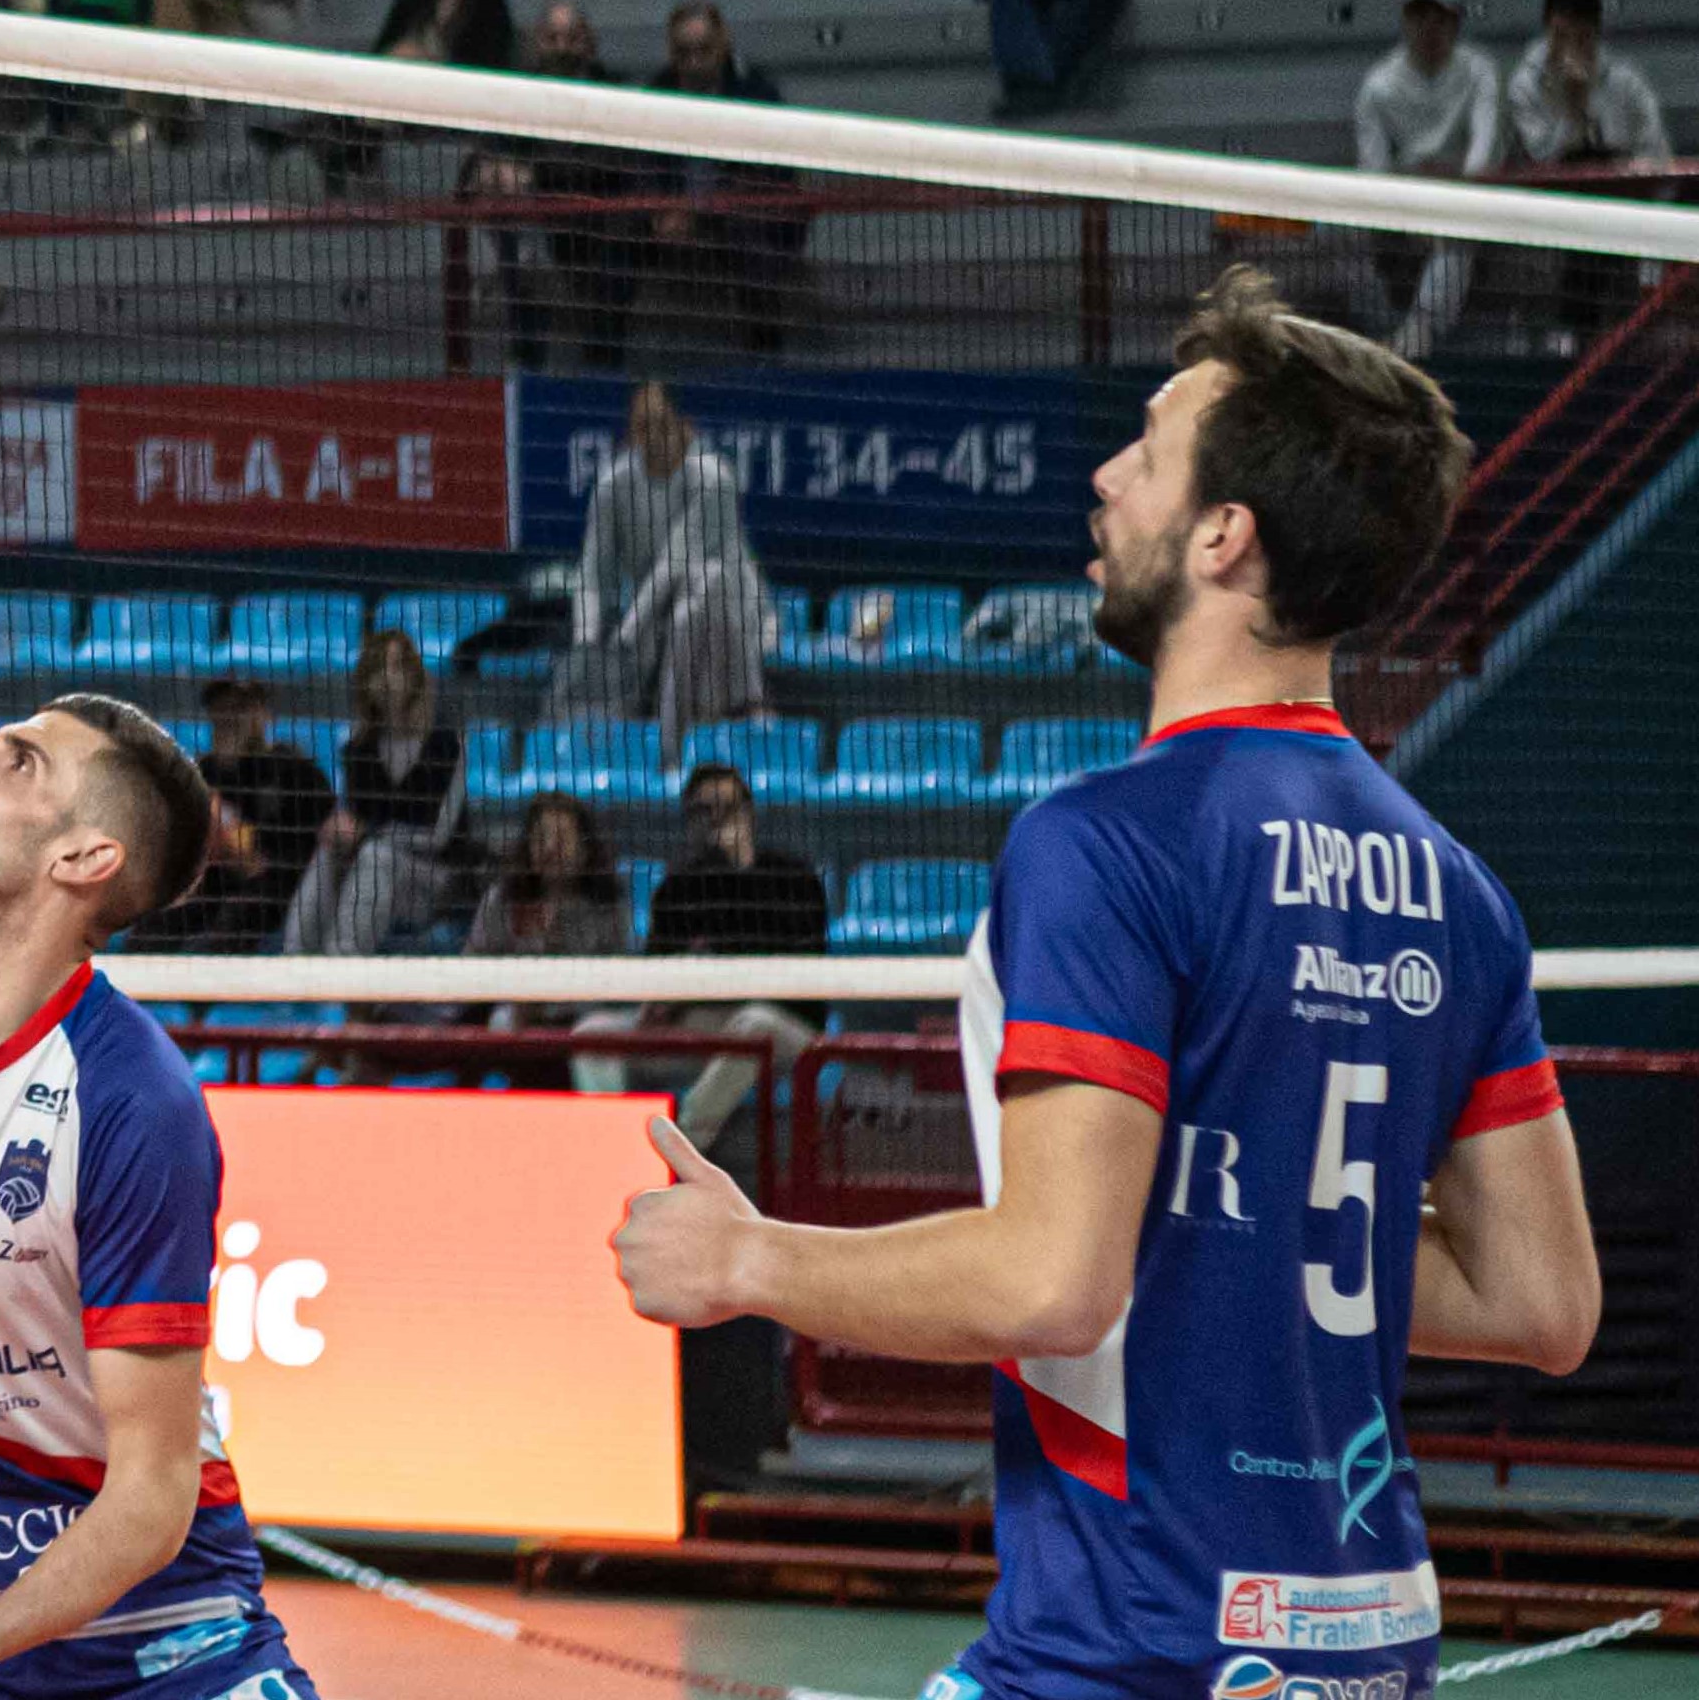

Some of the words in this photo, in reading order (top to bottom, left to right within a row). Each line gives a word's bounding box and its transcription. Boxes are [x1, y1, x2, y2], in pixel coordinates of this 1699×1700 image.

[134, 434, 282, 506] FILA
[305, 429, 437, 503] A-E
[806, 421, 1036, 498] 34-45
[1260, 819, 1444, 922] ZAPPOLI
[1167, 1123, 1257, 1222] R
[1303, 1060, 1389, 1337] 5
